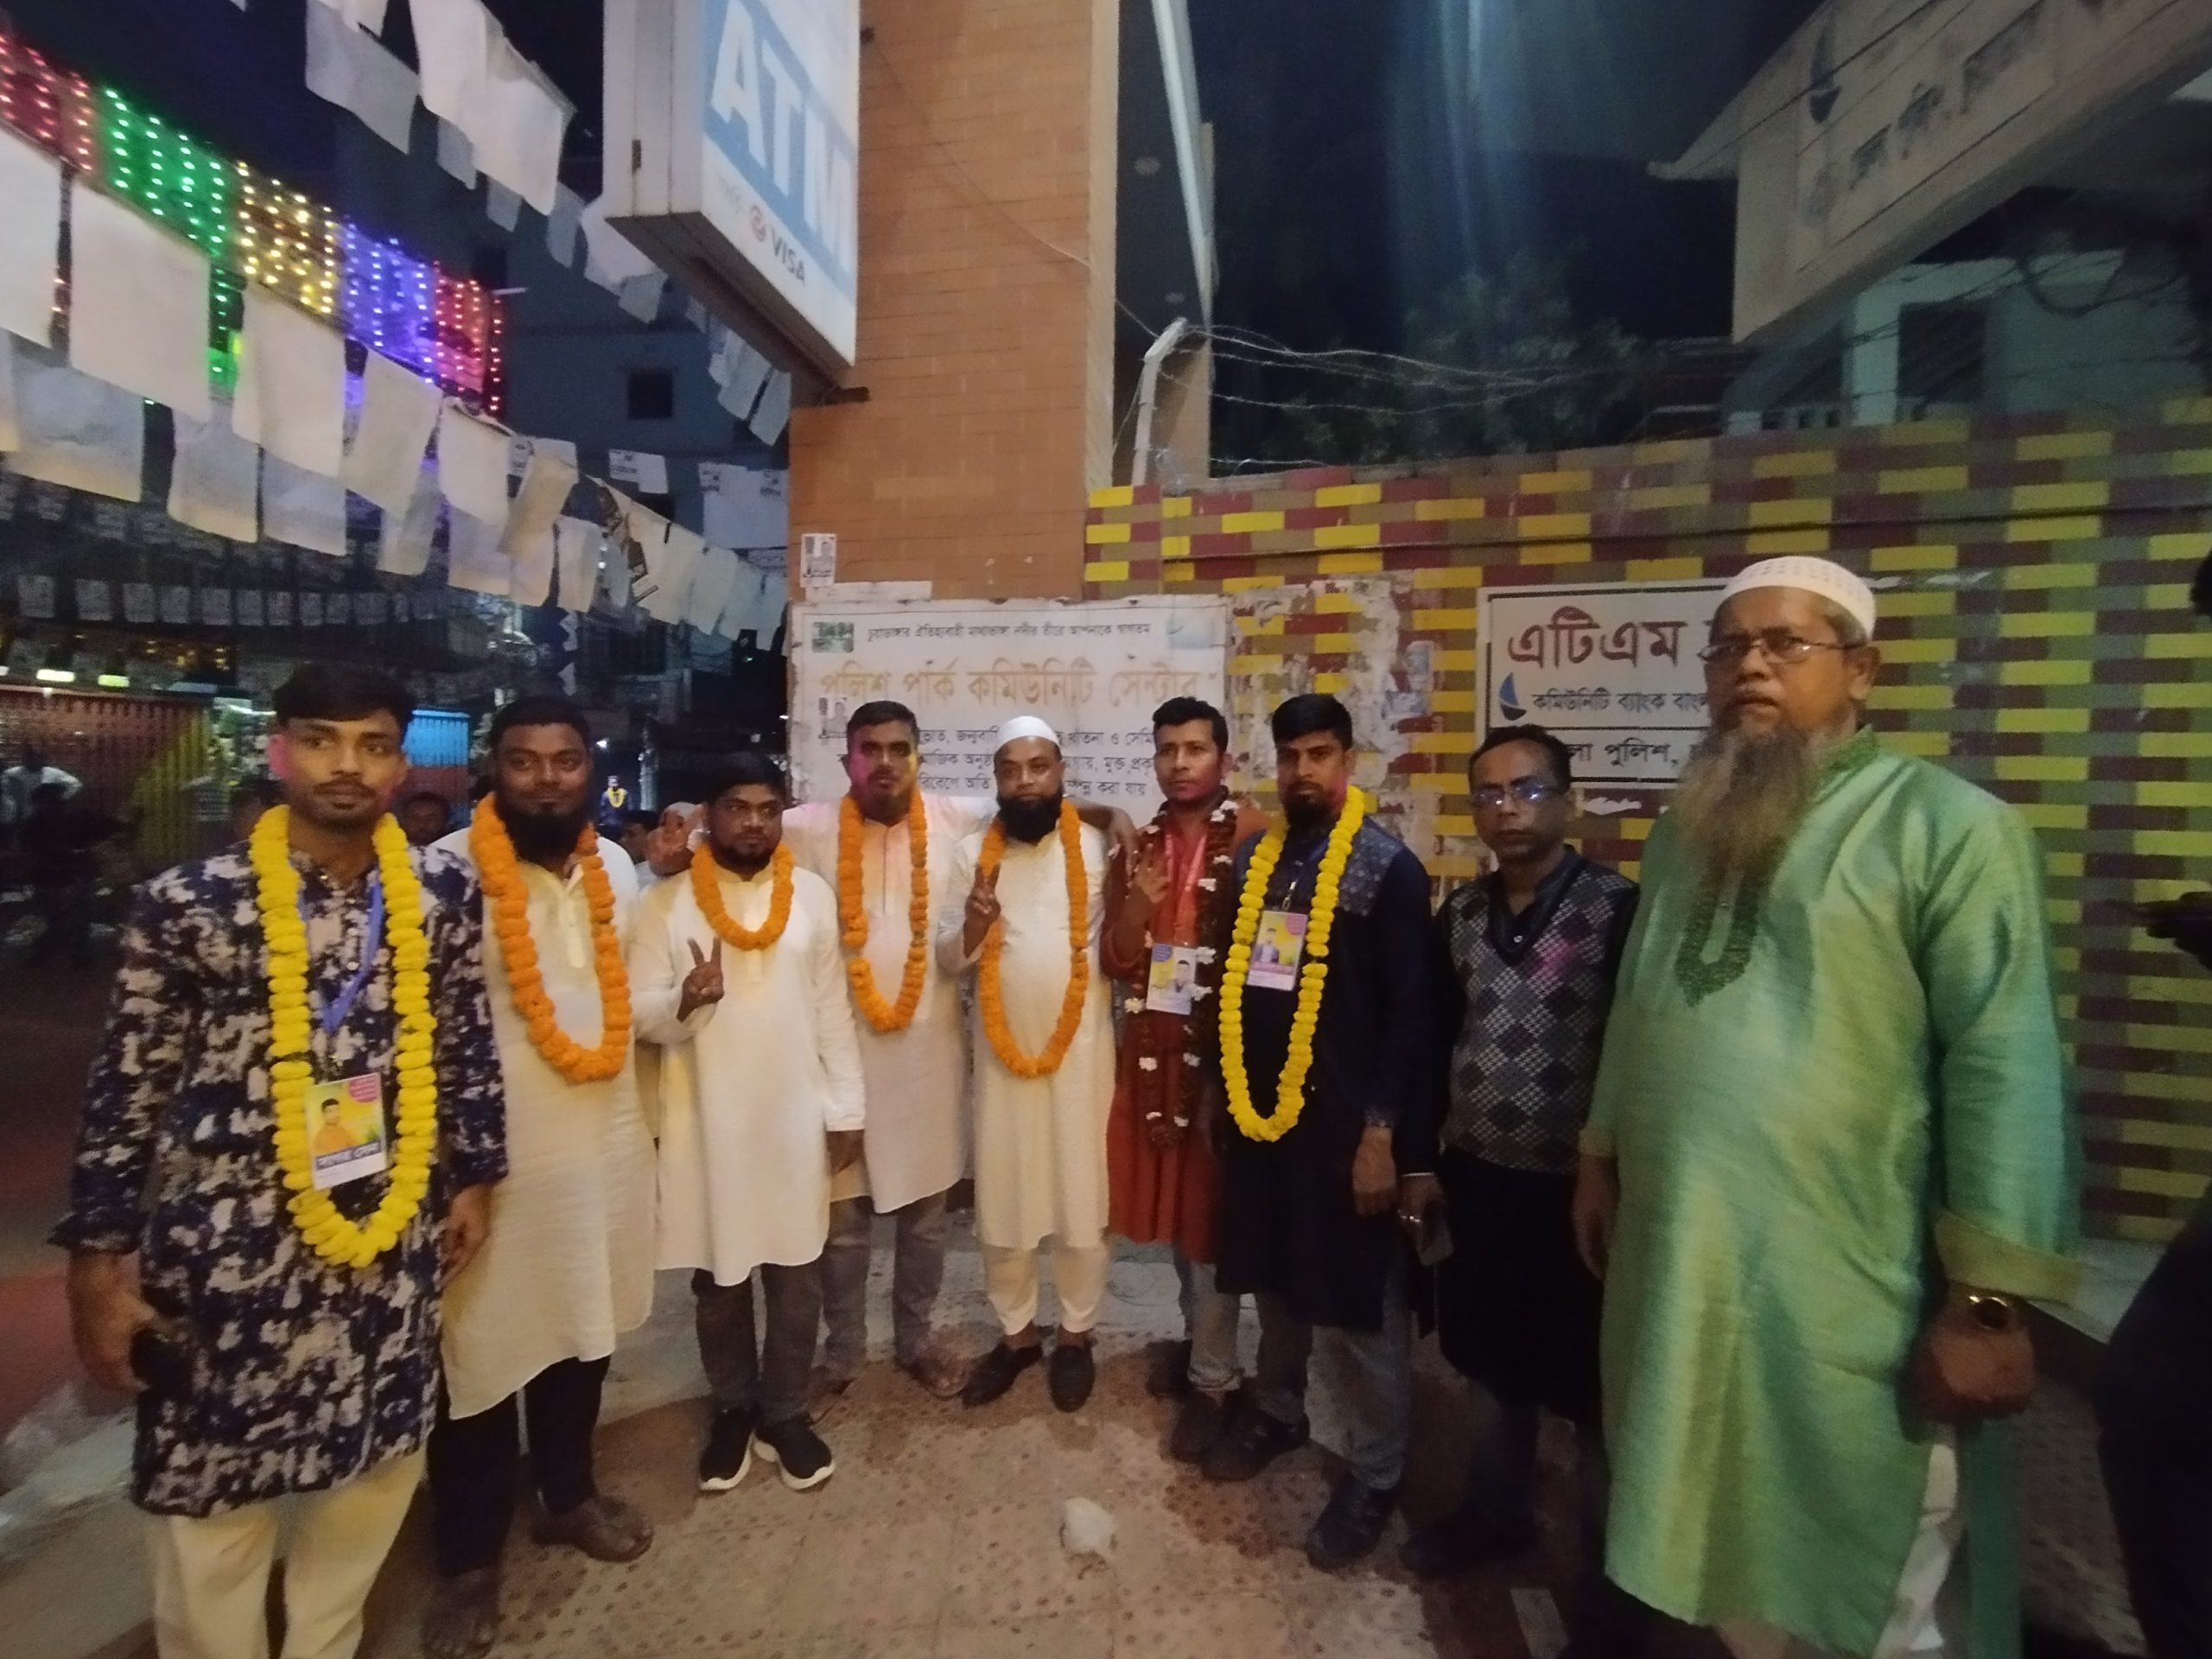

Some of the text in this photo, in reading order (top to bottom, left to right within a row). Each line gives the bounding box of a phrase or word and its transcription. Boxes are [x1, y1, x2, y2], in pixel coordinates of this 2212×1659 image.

[710, 0, 852, 276] ATM
[766, 222, 806, 287] VISA
[1508, 605, 1688, 670] এটিএম
[902, 656, 960, 706] পার্ক
[967, 655, 1098, 708] কমিউনিটি
[1531, 687, 1611, 711] কমিউনিটি
